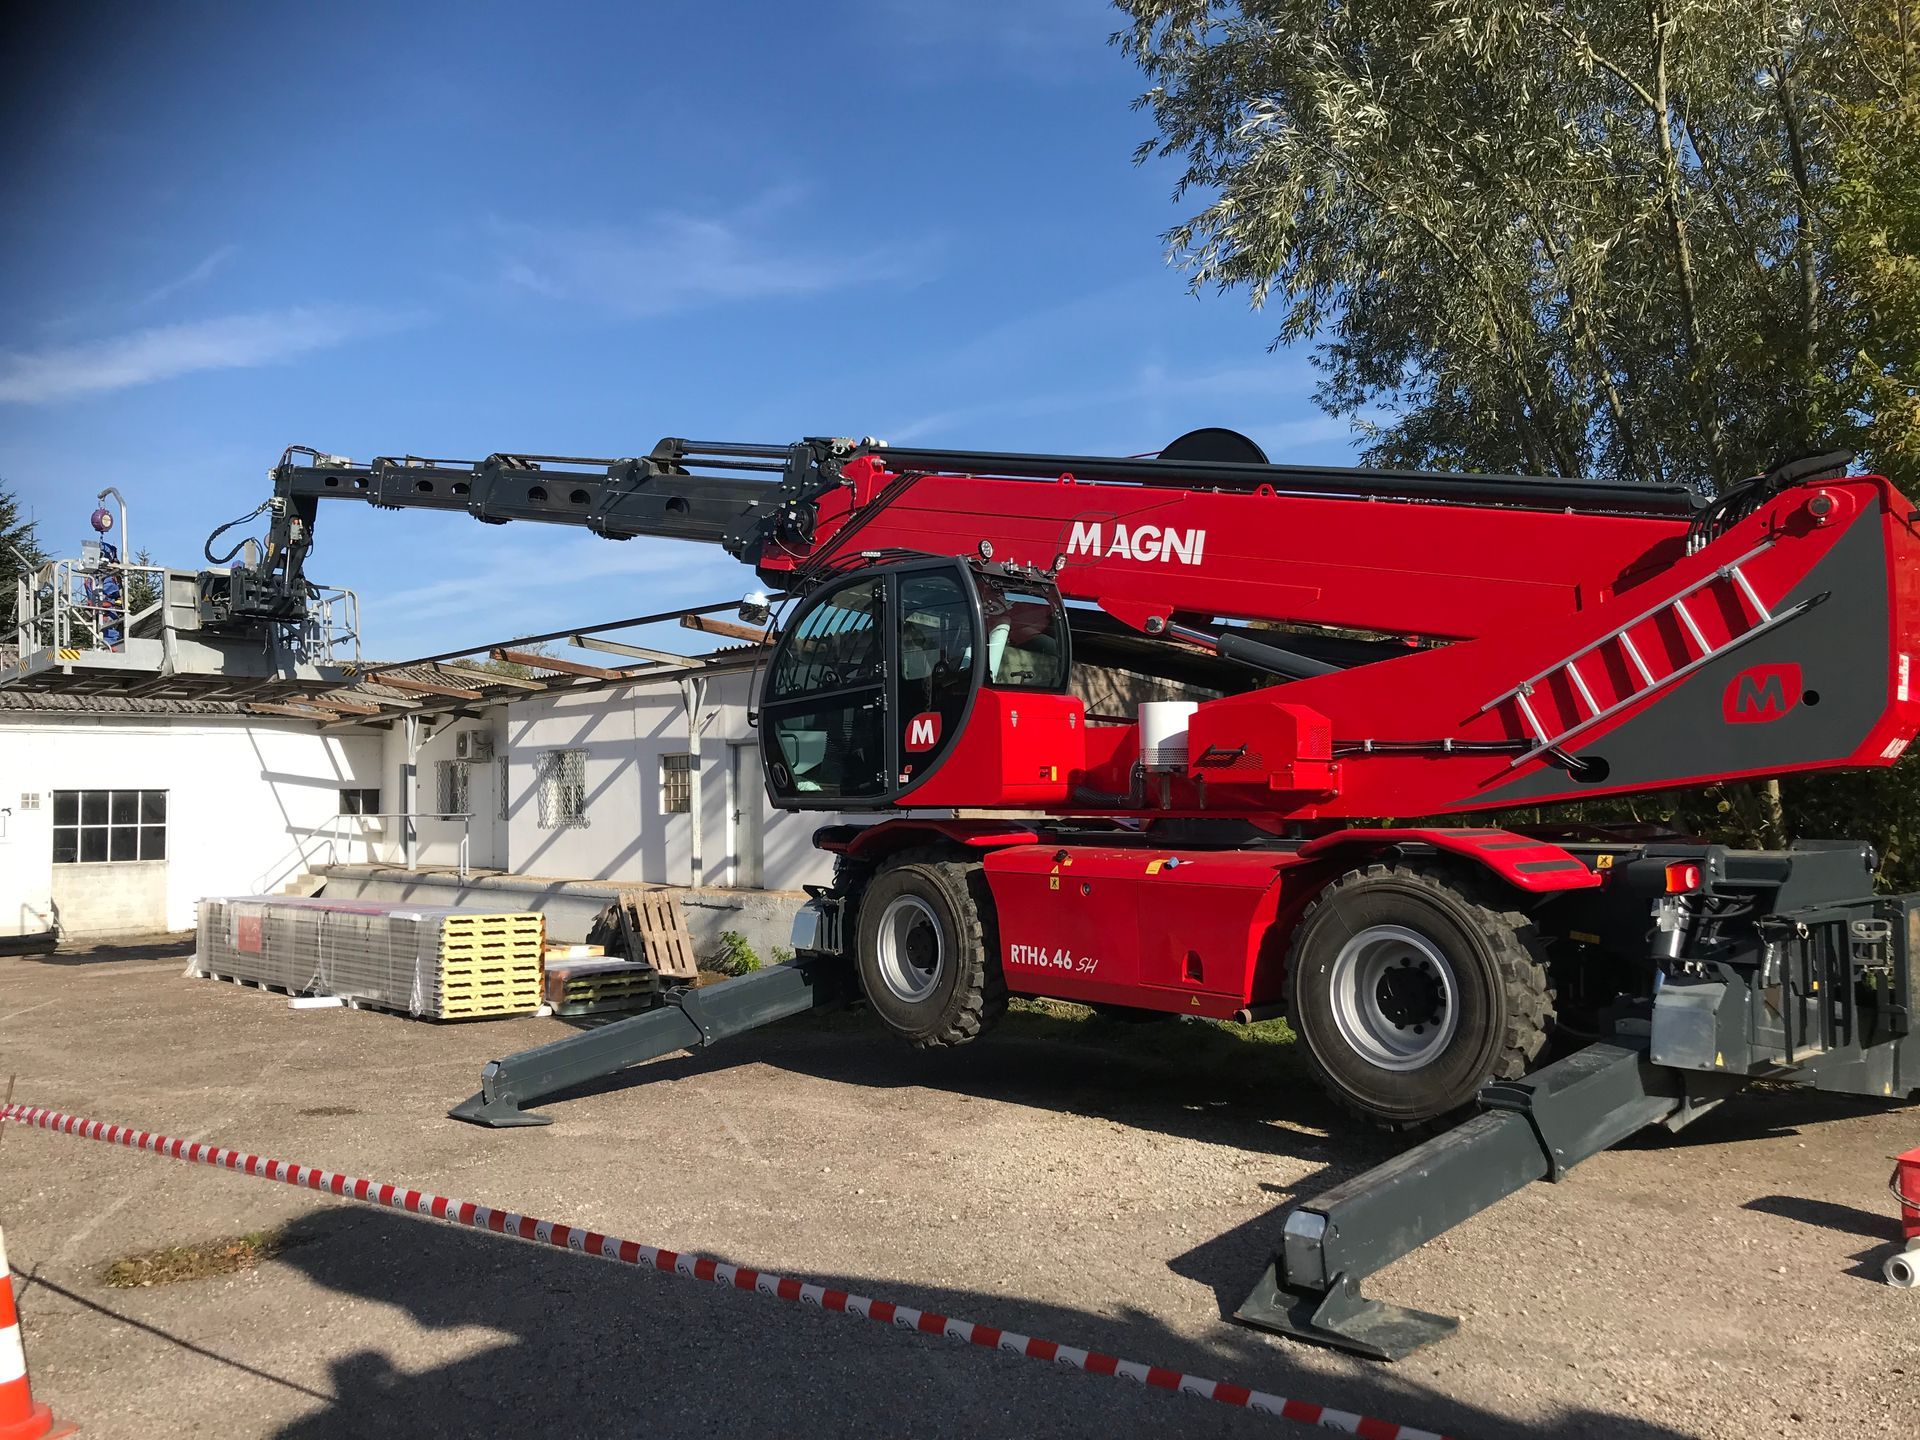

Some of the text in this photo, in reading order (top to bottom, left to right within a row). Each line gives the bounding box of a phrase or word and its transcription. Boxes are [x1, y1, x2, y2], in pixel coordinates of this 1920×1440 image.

[1066, 521, 1206, 566] MAGNI
[1736, 674, 1786, 713] M
[911, 719, 935, 745] M
[1011, 943, 1099, 974] RTH6.46 SH
